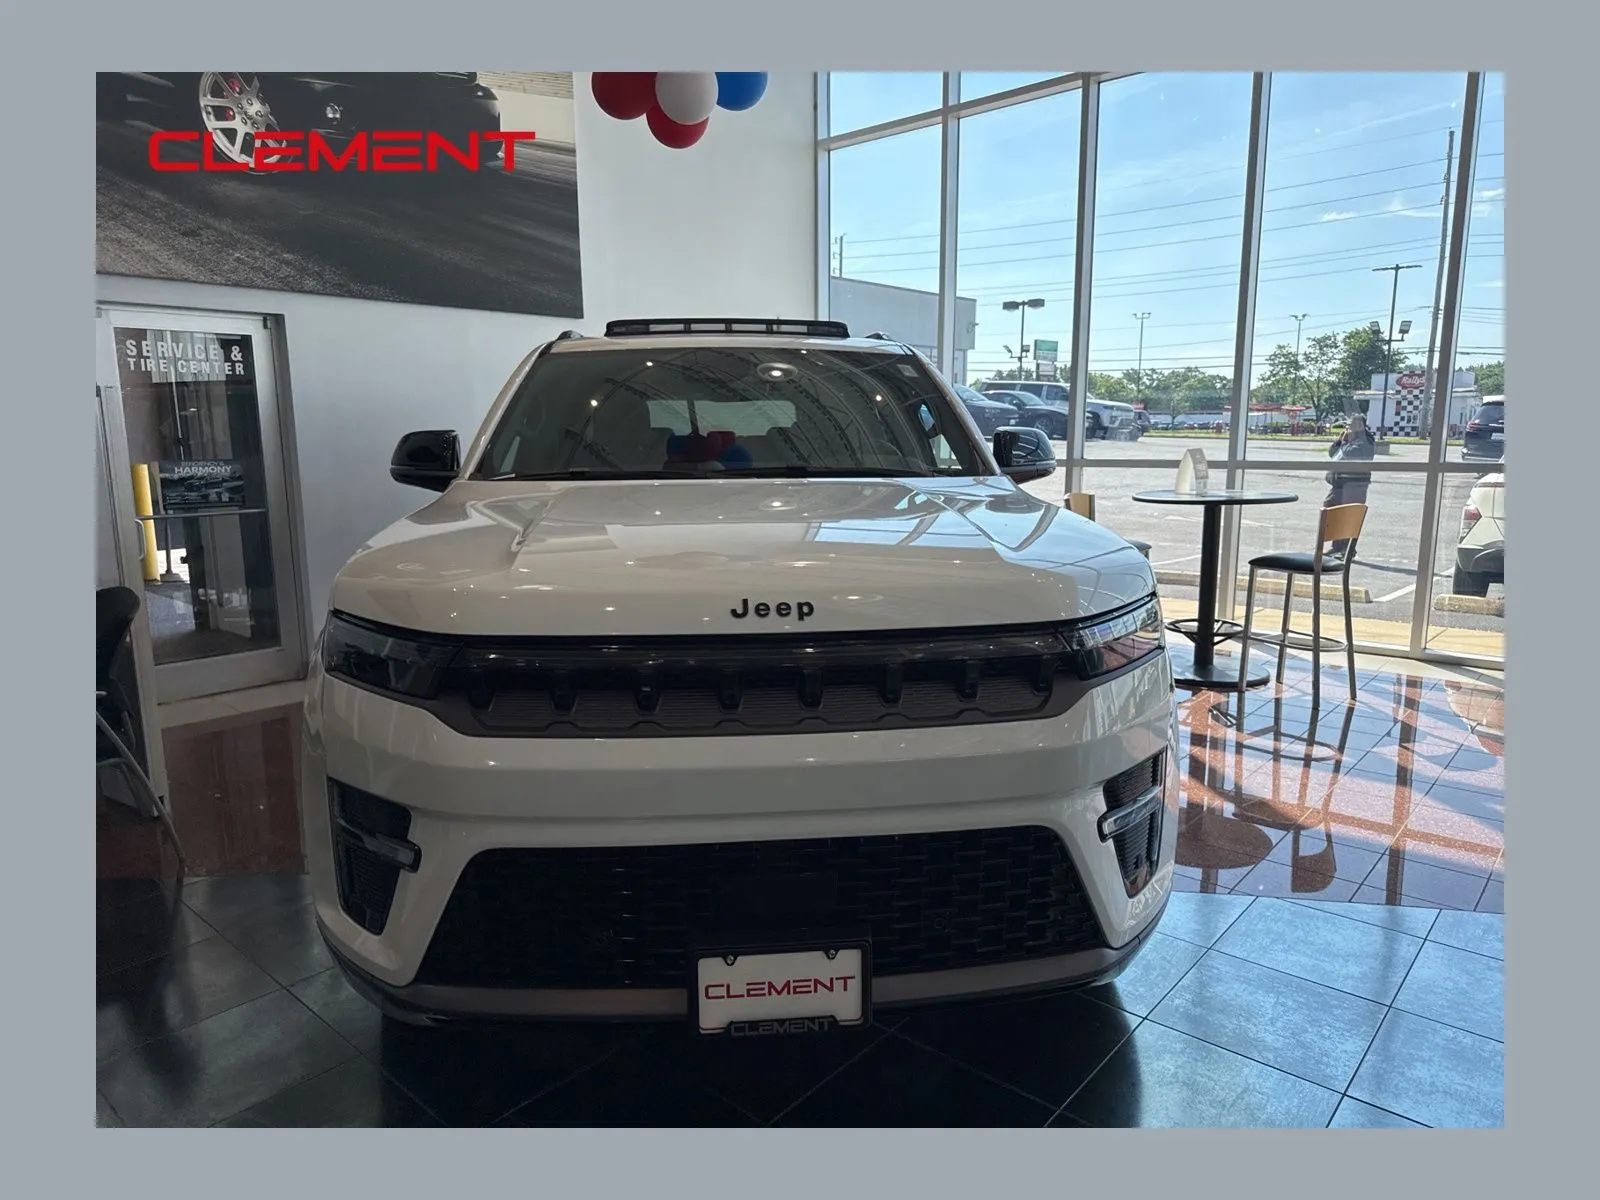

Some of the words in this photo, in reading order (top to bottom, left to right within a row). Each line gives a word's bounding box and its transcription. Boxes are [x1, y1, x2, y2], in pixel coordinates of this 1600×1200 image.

[125, 340, 219, 360] SERVICE
[230, 345, 242, 361] &
[127, 358, 168, 372] TIRE
[177, 360, 244, 375] CENTER
[174, 465, 232, 474] HARMONY
[730, 598, 814, 621] Jeep
[704, 974, 856, 1000] CLEMENT
[731, 1017, 834, 1036] CLEMENT
